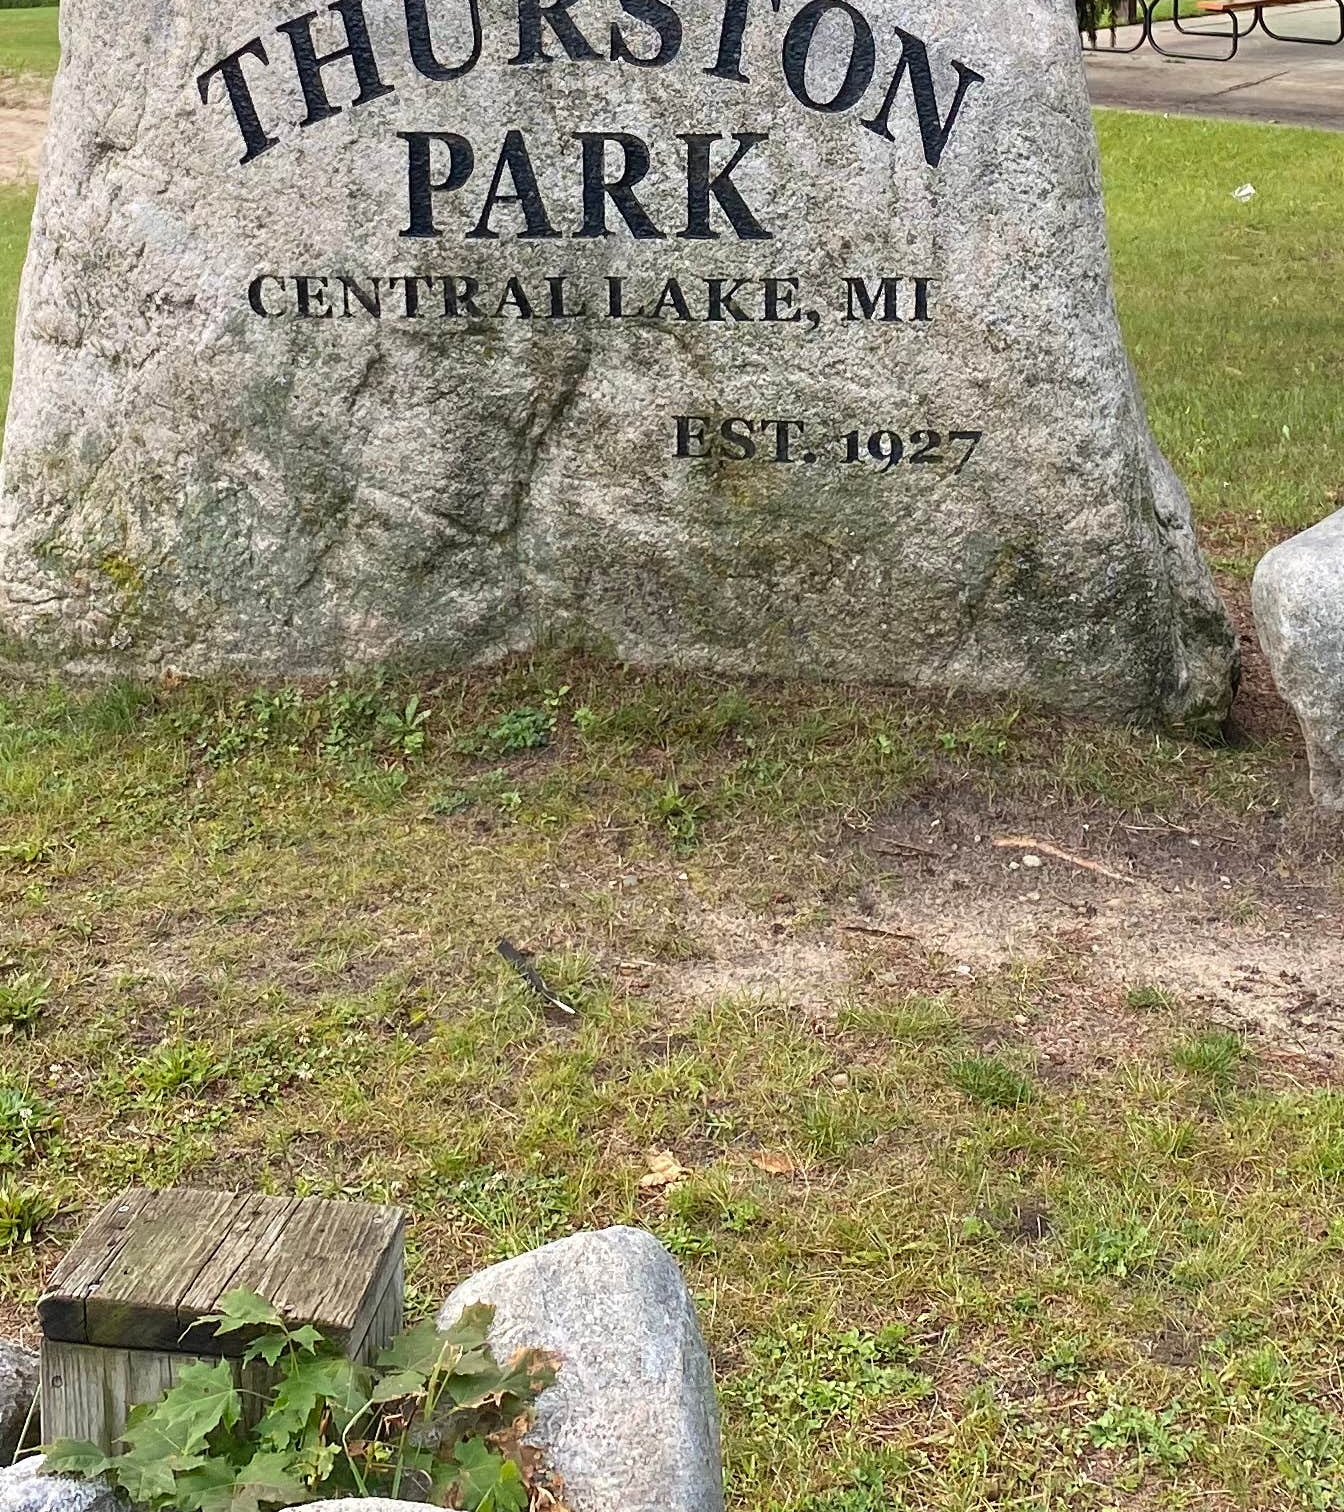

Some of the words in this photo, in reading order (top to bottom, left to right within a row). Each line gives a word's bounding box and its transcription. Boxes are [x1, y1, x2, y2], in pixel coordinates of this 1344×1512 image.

[397, 129, 774, 241] PARK
[248, 274, 586, 321] CENTRAL
[604, 275, 821, 331] LAKE,
[845, 276, 935, 322] MI
[672, 415, 815, 464] EST.
[838, 429, 983, 475] 1927
